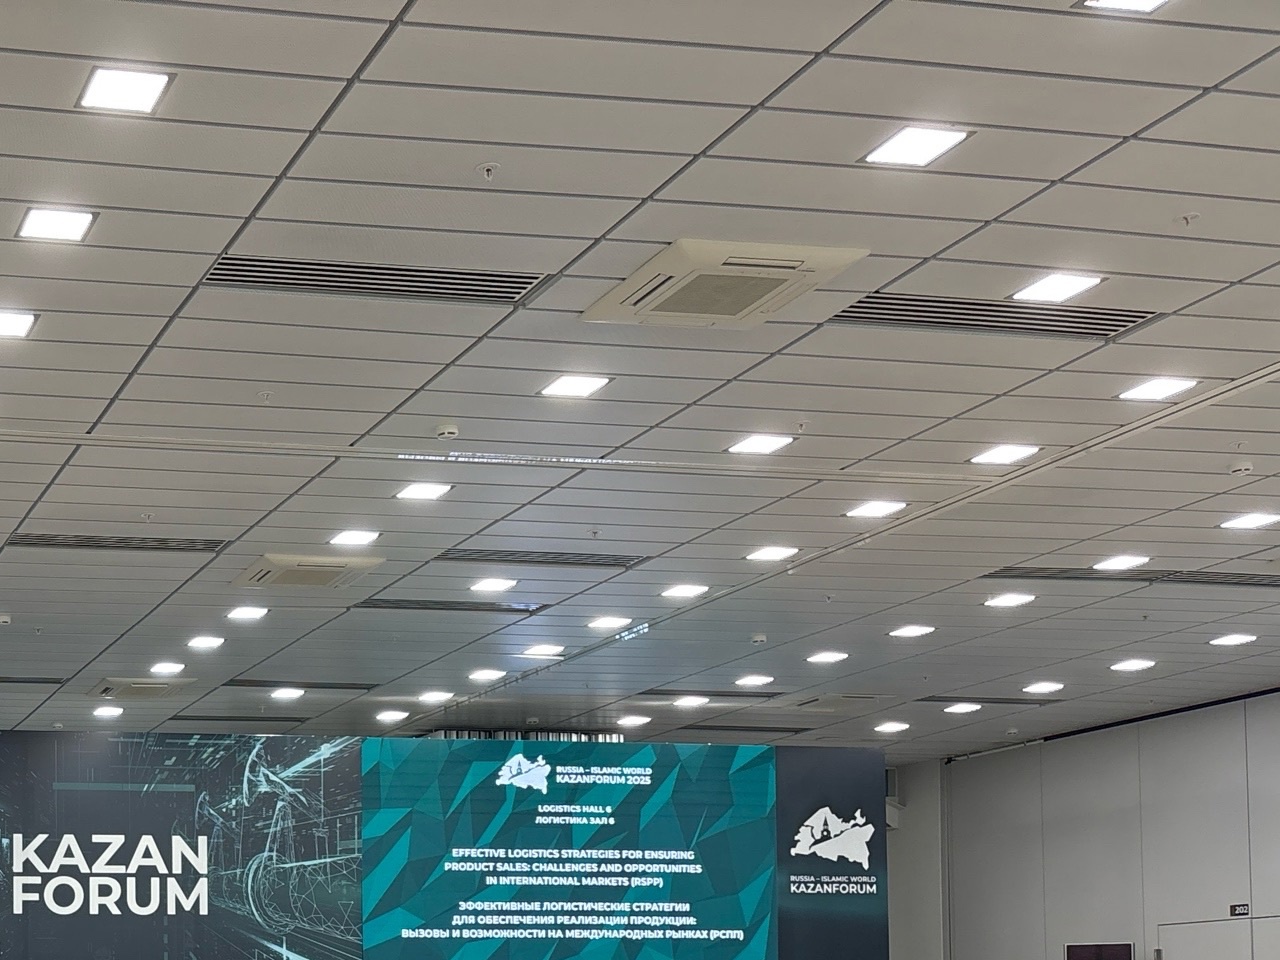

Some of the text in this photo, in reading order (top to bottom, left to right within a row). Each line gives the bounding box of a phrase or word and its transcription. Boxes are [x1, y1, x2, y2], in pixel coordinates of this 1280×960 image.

[556, 766, 652, 775] RUSSIA ISLAMIC WORLD
[556, 774, 652, 785] KAZANFORUM 2025
[538, 805, 581, 813] LOGISTICS
[582, 805, 605, 813] HALL
[535, 816, 615, 825] ЛОГИСТИКА ЗАЛ 6
[13, 833, 208, 875] KAZAN
[452, 849, 695, 860] EFFECTIVE LOGISTICS STRATEGIES FOR ENSURING
[444, 862, 702, 873] PRODUCT SALES: CHALLENGES AND OPPORTUNITIES
[486, 876, 664, 888] IN INTERNATIONAL MARKETS (RSPP)
[790, 883, 877, 894] KAZANFORUM
[13, 875, 208, 915] FORUM
[458, 901, 690, 912] ЭФФЕКТИВНЫЕ ЛОГИСТИЧЕСКИЕ СТРАТЕГИИ
[1235, 906, 1248, 914] 202
[452, 915, 697, 926] ДЛЯ ОБЕСПЕЧЕНИЯ РЕАЛИЗАЦИИ ПРОДУКЦИИ:
[401, 929, 744, 940] ВЫЗОВЫ И ВОЗМОЖНОСТИ НА МЕЖДУНАРОДНЫХ РЫНКАХ (РСПП)
